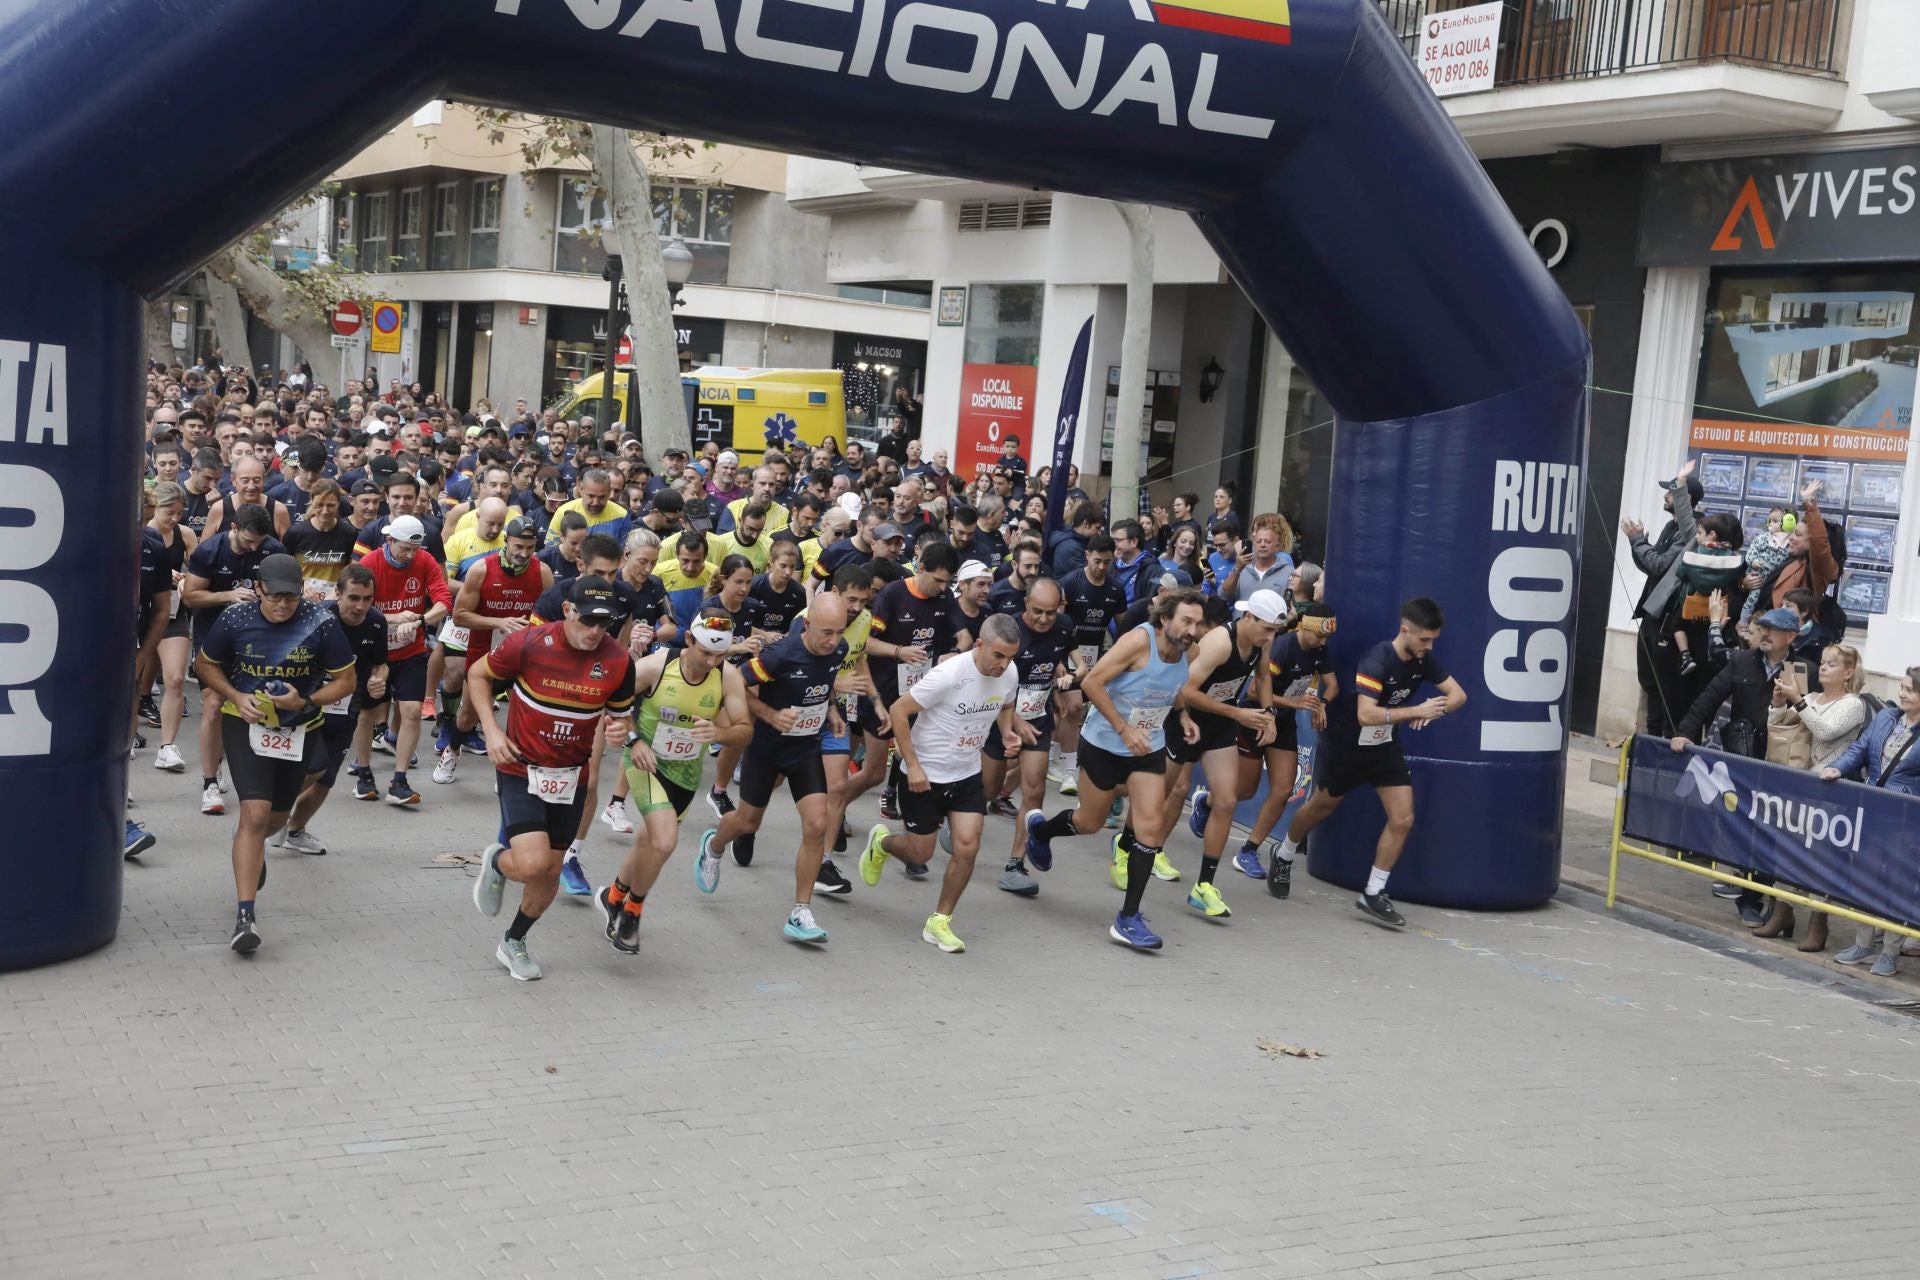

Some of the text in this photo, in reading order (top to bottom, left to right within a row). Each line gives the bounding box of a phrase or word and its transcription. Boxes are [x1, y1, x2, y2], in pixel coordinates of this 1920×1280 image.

[1425, 37, 1491, 61] SE ALQUILA
[1445, 63, 1466, 82] 890
[1469, 60, 1489, 79] 086
[1775, 164, 1916, 222] VIVES
[865, 345, 902, 359] MACSON
[982, 379, 1012, 393] LOCAL
[971, 393, 1023, 411] DISPONIBLE
[1693, 427, 1731, 441] ESTUDIO
[1734, 430, 1746, 442] DE
[1748, 430, 1819, 447] ARQUITECTURA
[1823, 435, 1831, 447] Y
[1492, 459, 1579, 535] RUTA
[486, 600, 533, 611] NUCLEO DURO
[450, 628, 469, 643] 180
[542, 677, 602, 697] KAMIKAZES
[805, 684, 829, 698] 200
[795, 717, 820, 730] 499
[261, 734, 291, 750] 324
[539, 730, 580, 742] MARTINEZ
[665, 741, 693, 754] 150
[540, 780, 568, 794] 387
[1748, 790, 1864, 852] mupol
